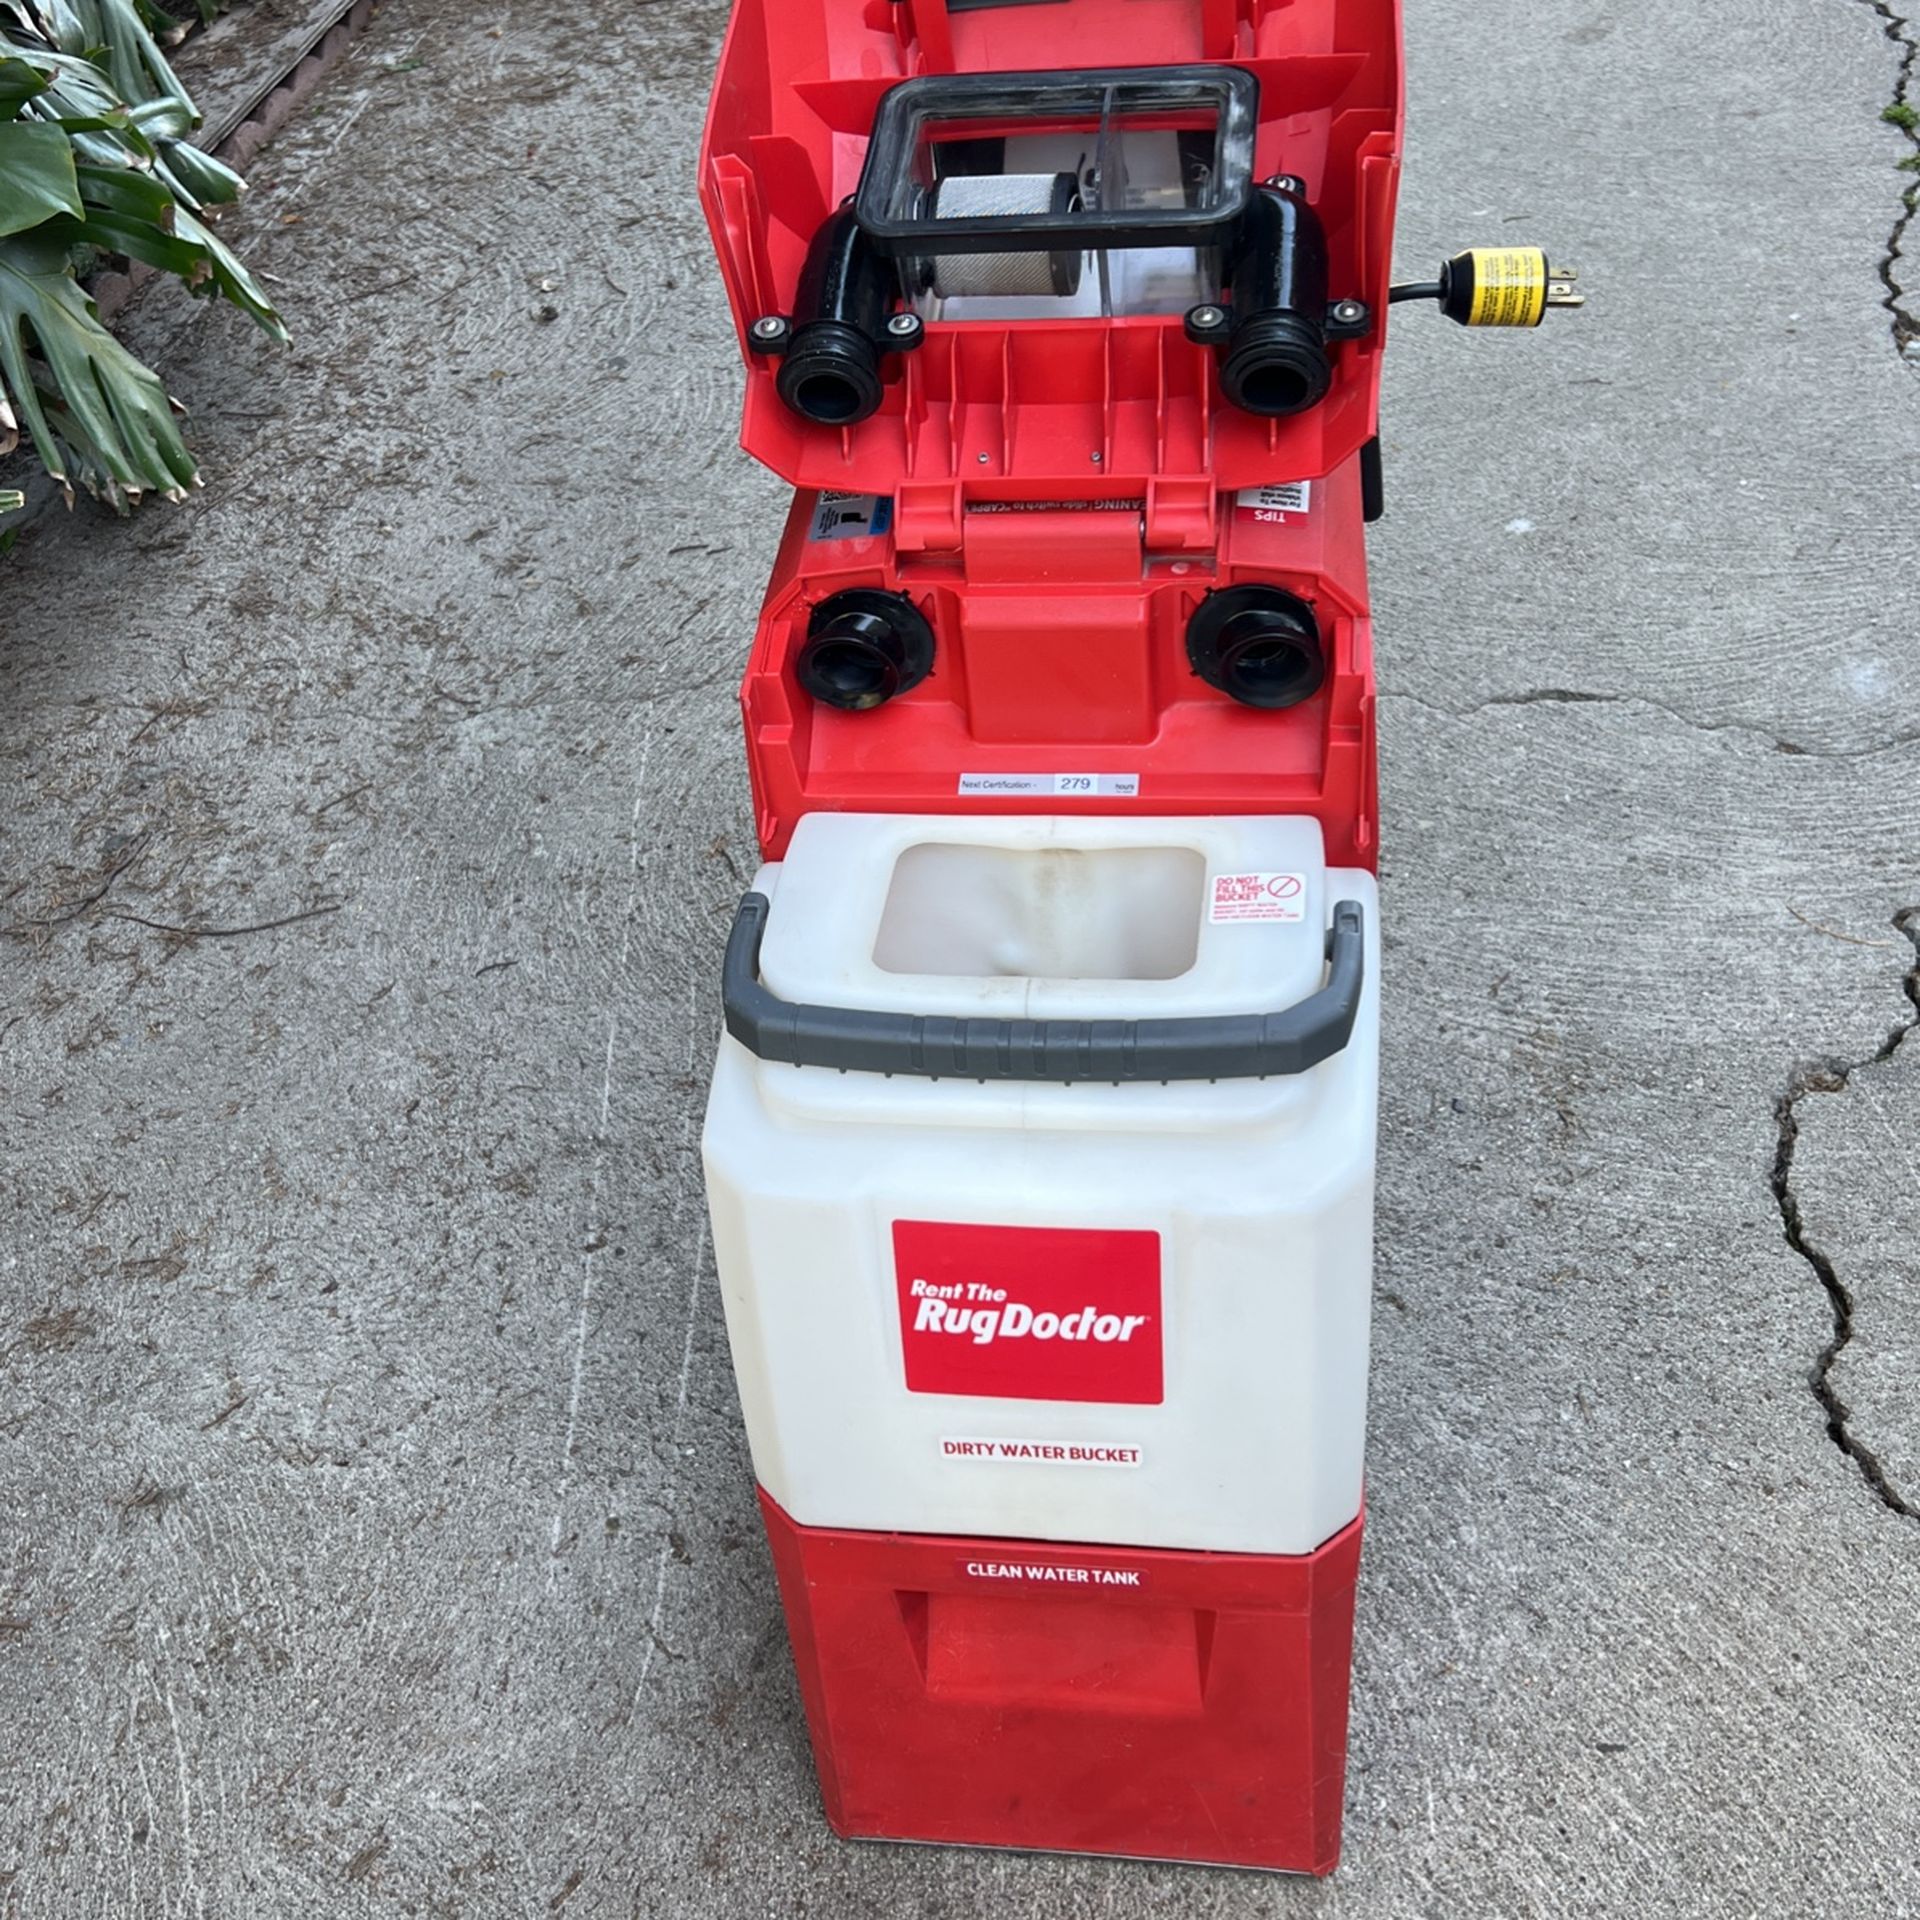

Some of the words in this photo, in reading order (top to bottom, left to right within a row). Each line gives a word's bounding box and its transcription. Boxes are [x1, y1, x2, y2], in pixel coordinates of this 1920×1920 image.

[1254, 509, 1286, 523] TIPS
[962, 780, 981, 789] Next
[1060, 777, 1091, 790] 279
[1217, 877, 1234, 886] DO
[1236, 875, 1260, 885] NOT
[1216, 885, 1237, 893] FILL
[1241, 884, 1265, 892] THIS
[1215, 892, 1259, 902] BUCKET
[910, 1279, 964, 1300] Rent
[966, 1283, 1007, 1302] The
[913, 1297, 1145, 1345] RugDoctor
[943, 1441, 997, 1457] DIRTY
[999, 1444, 1065, 1460] WATER
[1069, 1447, 1139, 1463] BUCKET
[967, 1562, 1024, 1579] CLEAN
[1026, 1565, 1090, 1583] WATER
[1091, 1569, 1140, 1586] TANK
